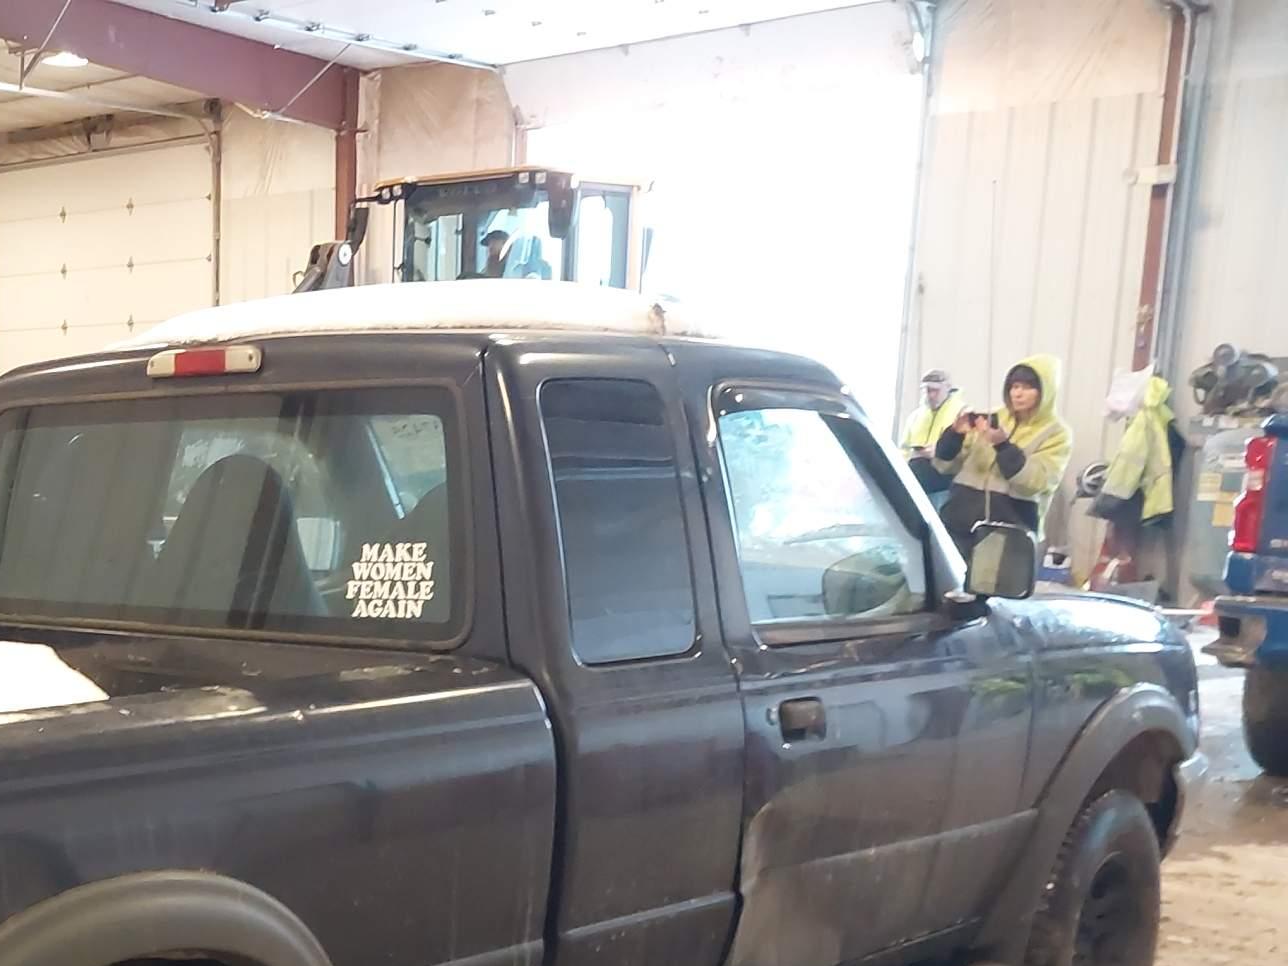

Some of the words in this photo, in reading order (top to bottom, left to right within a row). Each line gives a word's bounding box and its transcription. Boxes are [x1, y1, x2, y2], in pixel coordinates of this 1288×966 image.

[360, 542, 427, 562] MAKE
[351, 561, 434, 581] WOMEN
[345, 580, 434, 600] FEMALE
[351, 599, 425, 619] AGAIN
